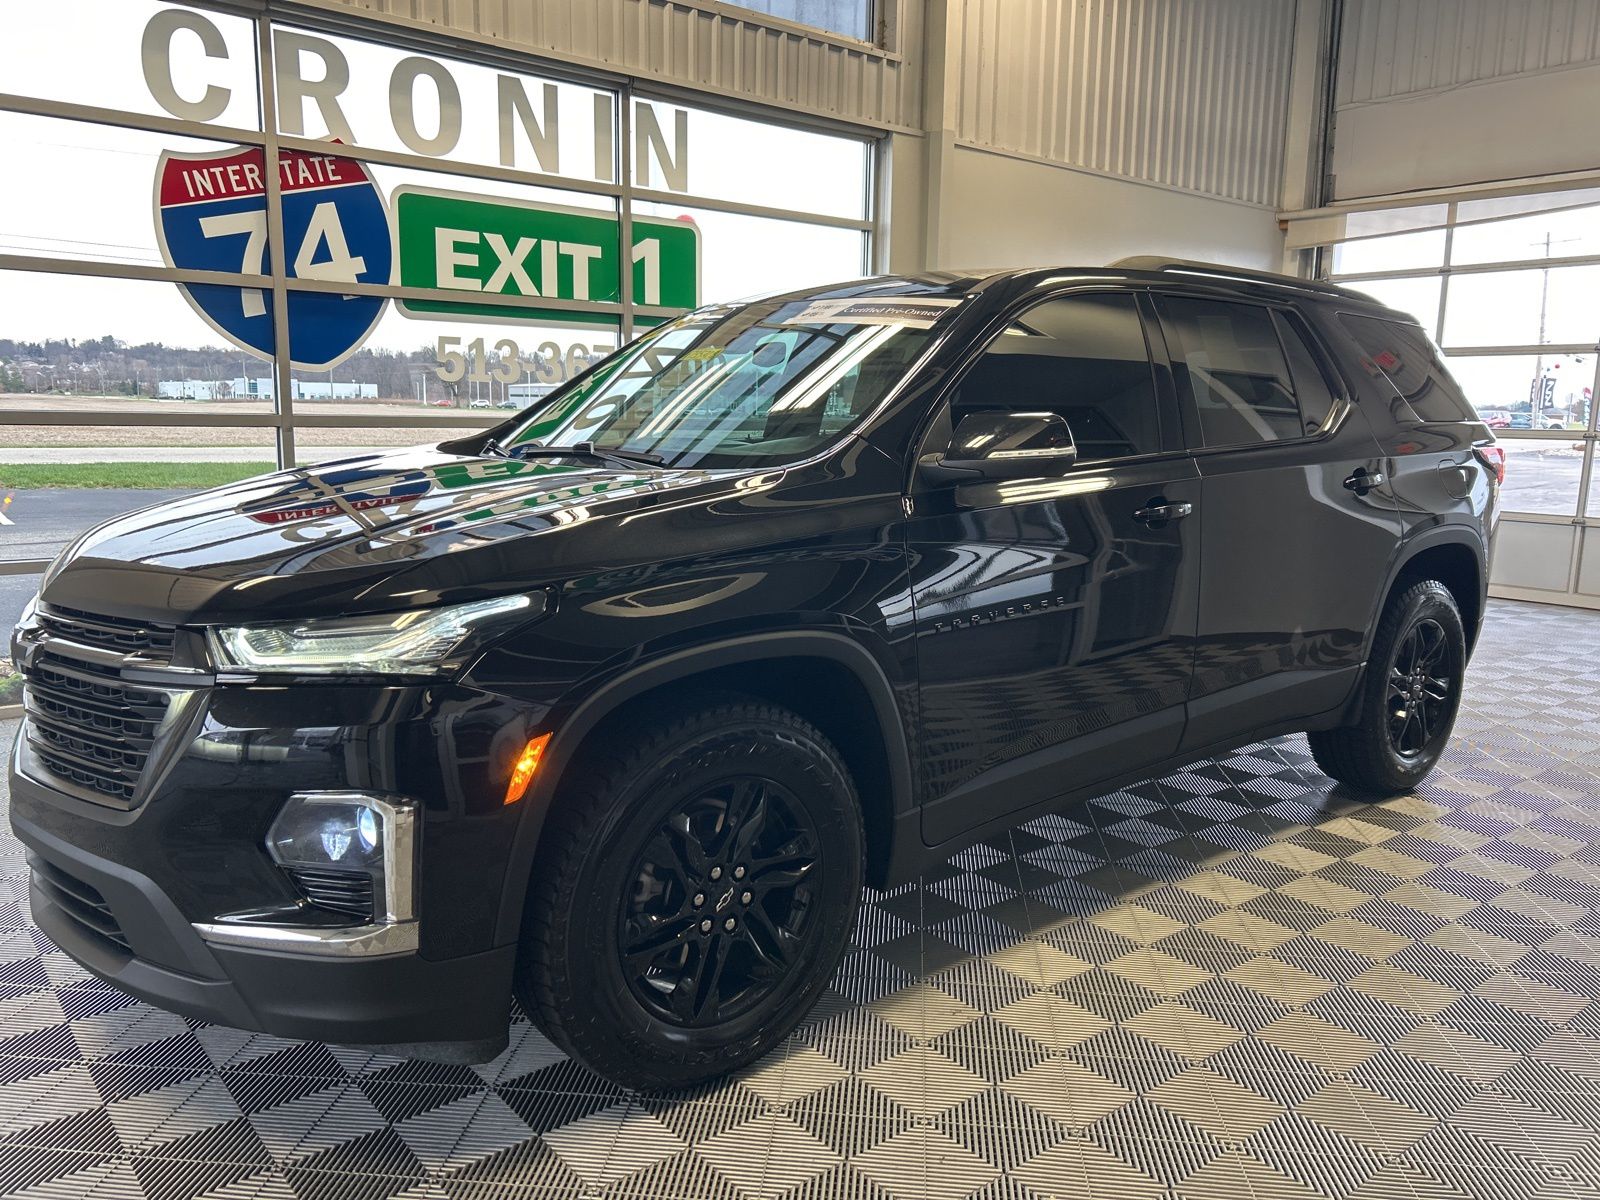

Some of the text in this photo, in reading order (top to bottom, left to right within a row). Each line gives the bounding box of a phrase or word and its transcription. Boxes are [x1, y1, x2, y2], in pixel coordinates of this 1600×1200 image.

[141, 9, 688, 191] CRONIN
[183, 156, 342, 198] INTERTATE
[199, 202, 367, 317] 74
[435, 227, 660, 305] EXIT 1
[843, 306, 885, 315] Certified
[886, 307, 943, 317] Pre-Owned
[934, 597, 1064, 632] TRAVERSE
